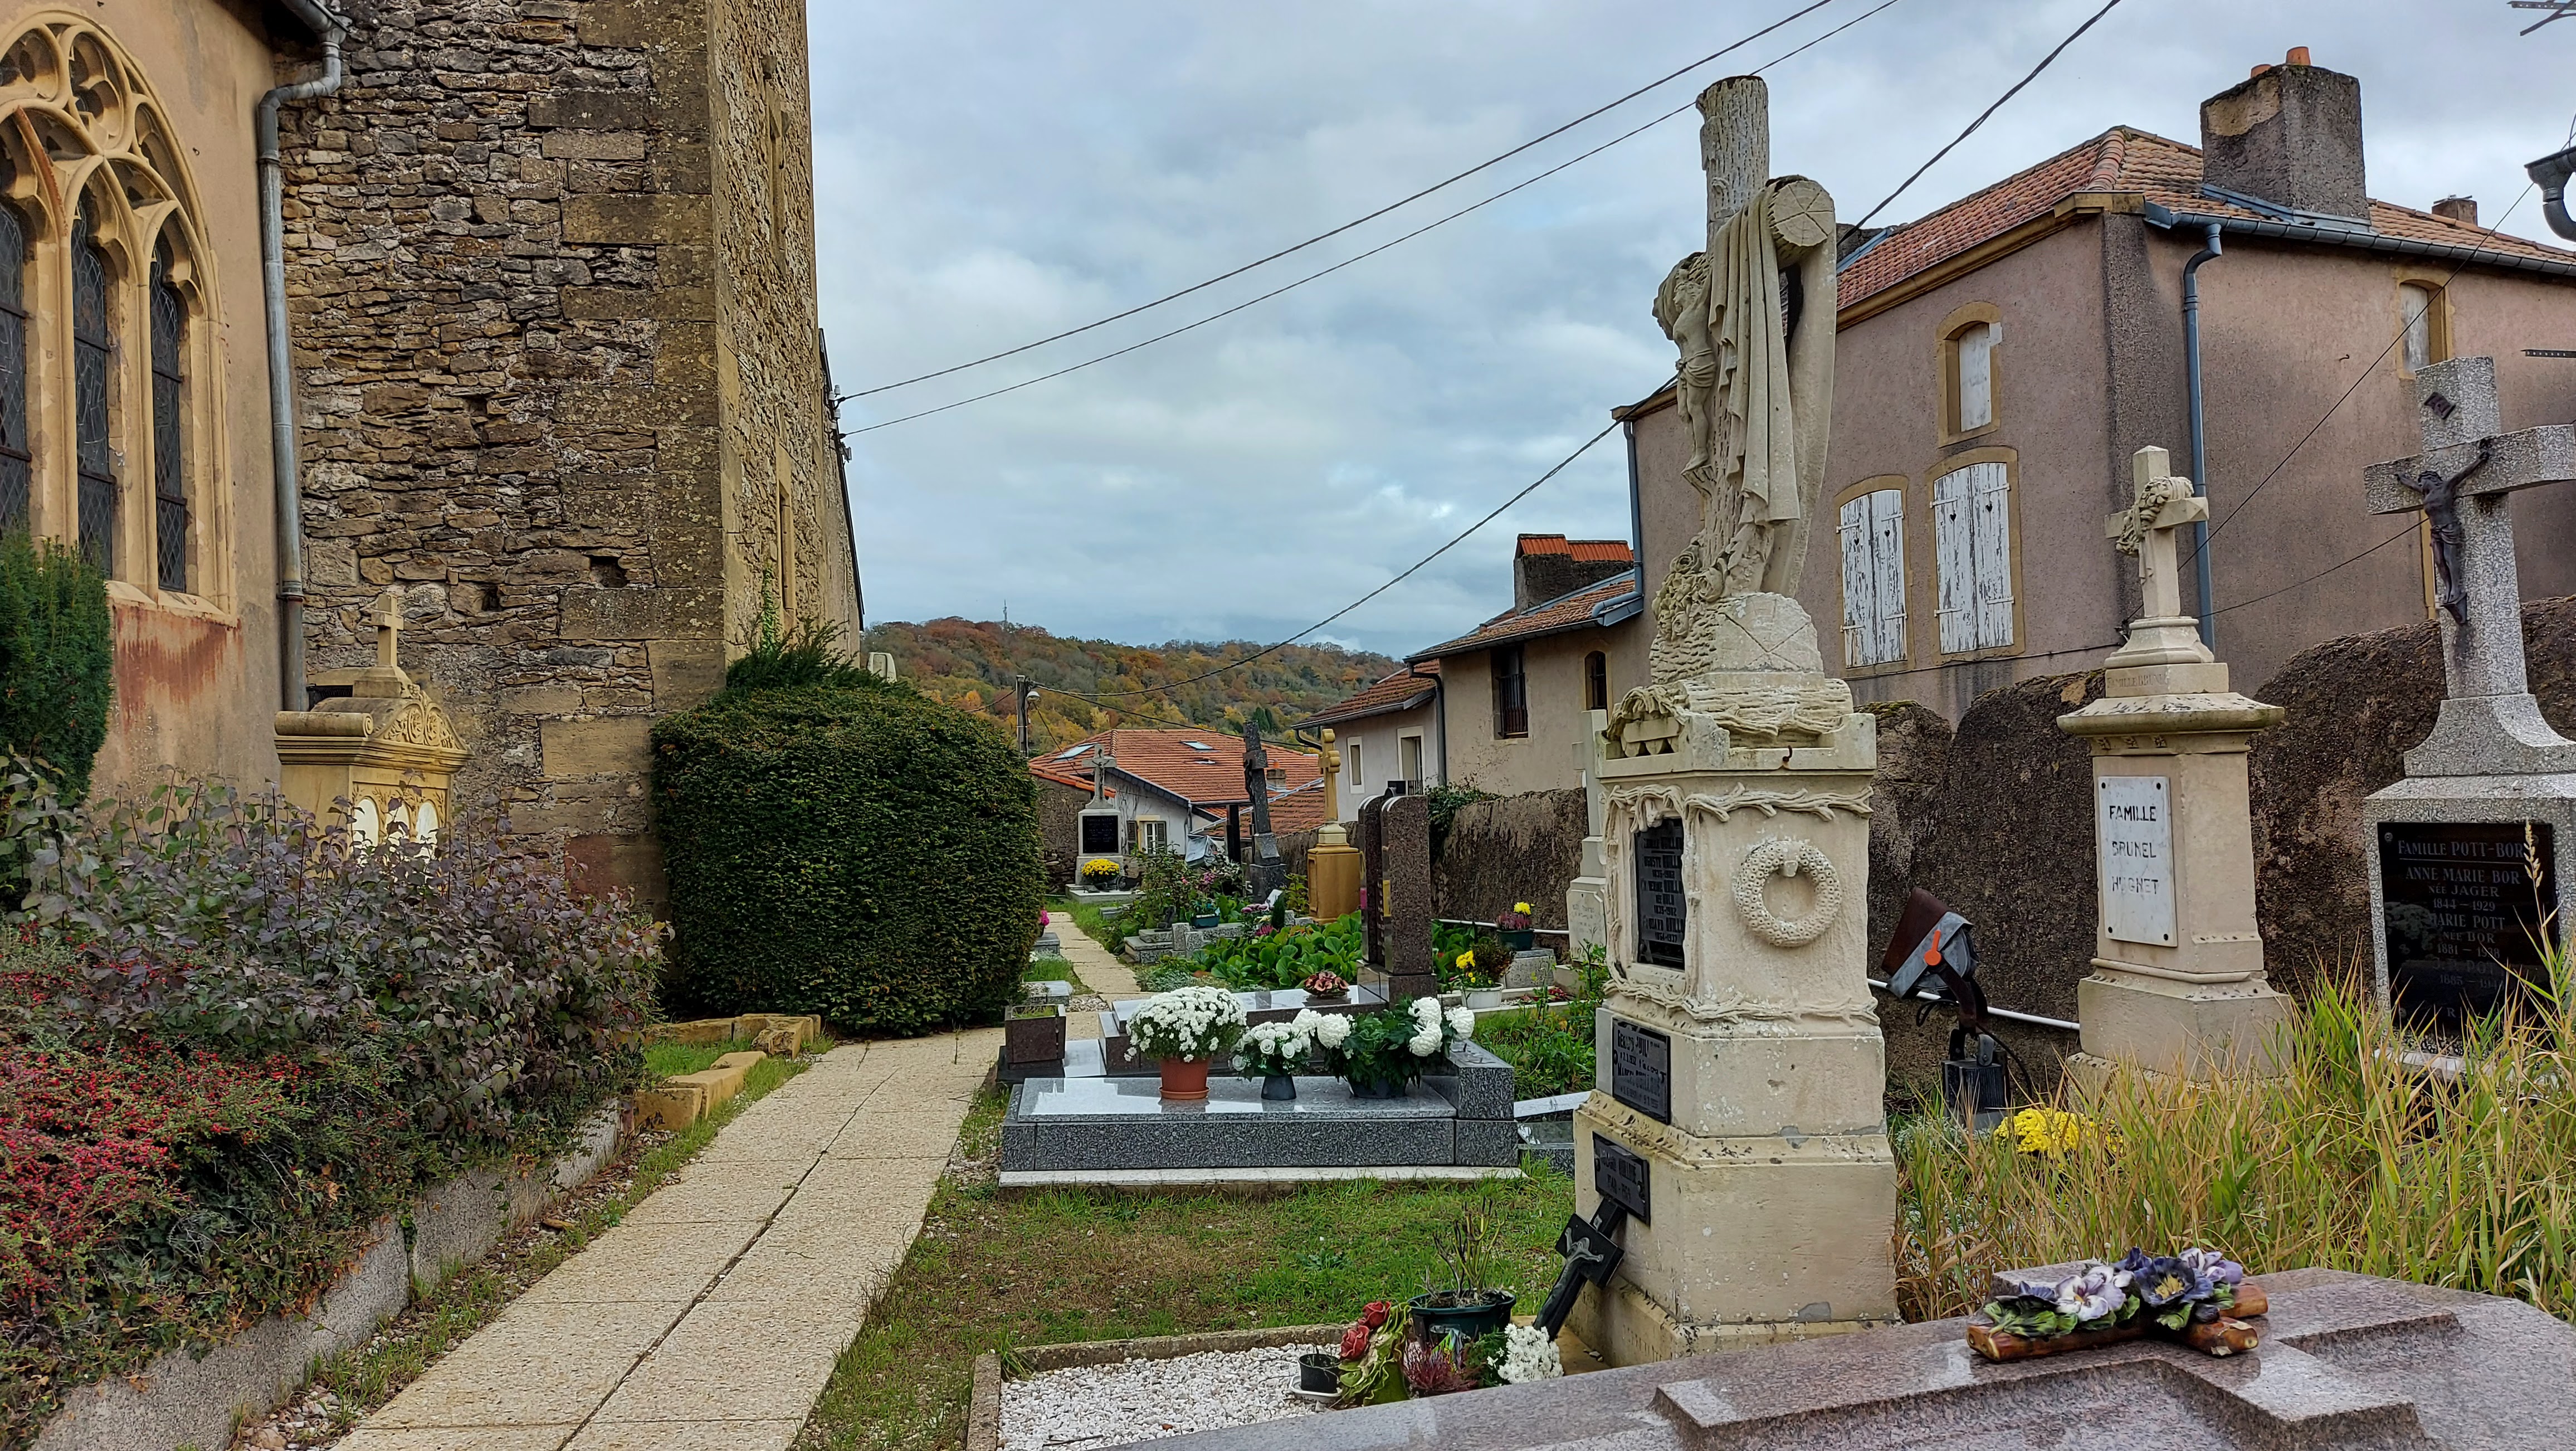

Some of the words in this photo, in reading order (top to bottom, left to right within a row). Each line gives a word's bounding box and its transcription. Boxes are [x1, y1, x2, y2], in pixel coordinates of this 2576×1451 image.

[2109, 805, 2157, 822] FAMILLE
[2111, 841, 2157, 858] BRUNEL
[2398, 840, 2447, 856] FAMILLE
[2406, 866, 2439, 881] ANNE
[2442, 868, 2486, 883] MARIE
[2492, 870, 2521, 884] BOR
[2433, 898, 2457, 910] 1844
[2472, 900, 2496, 912] 1929
[2473, 915, 2505, 931] POTT
[2467, 932, 2496, 944] BOR
[2437, 943, 2458, 955] 1881
